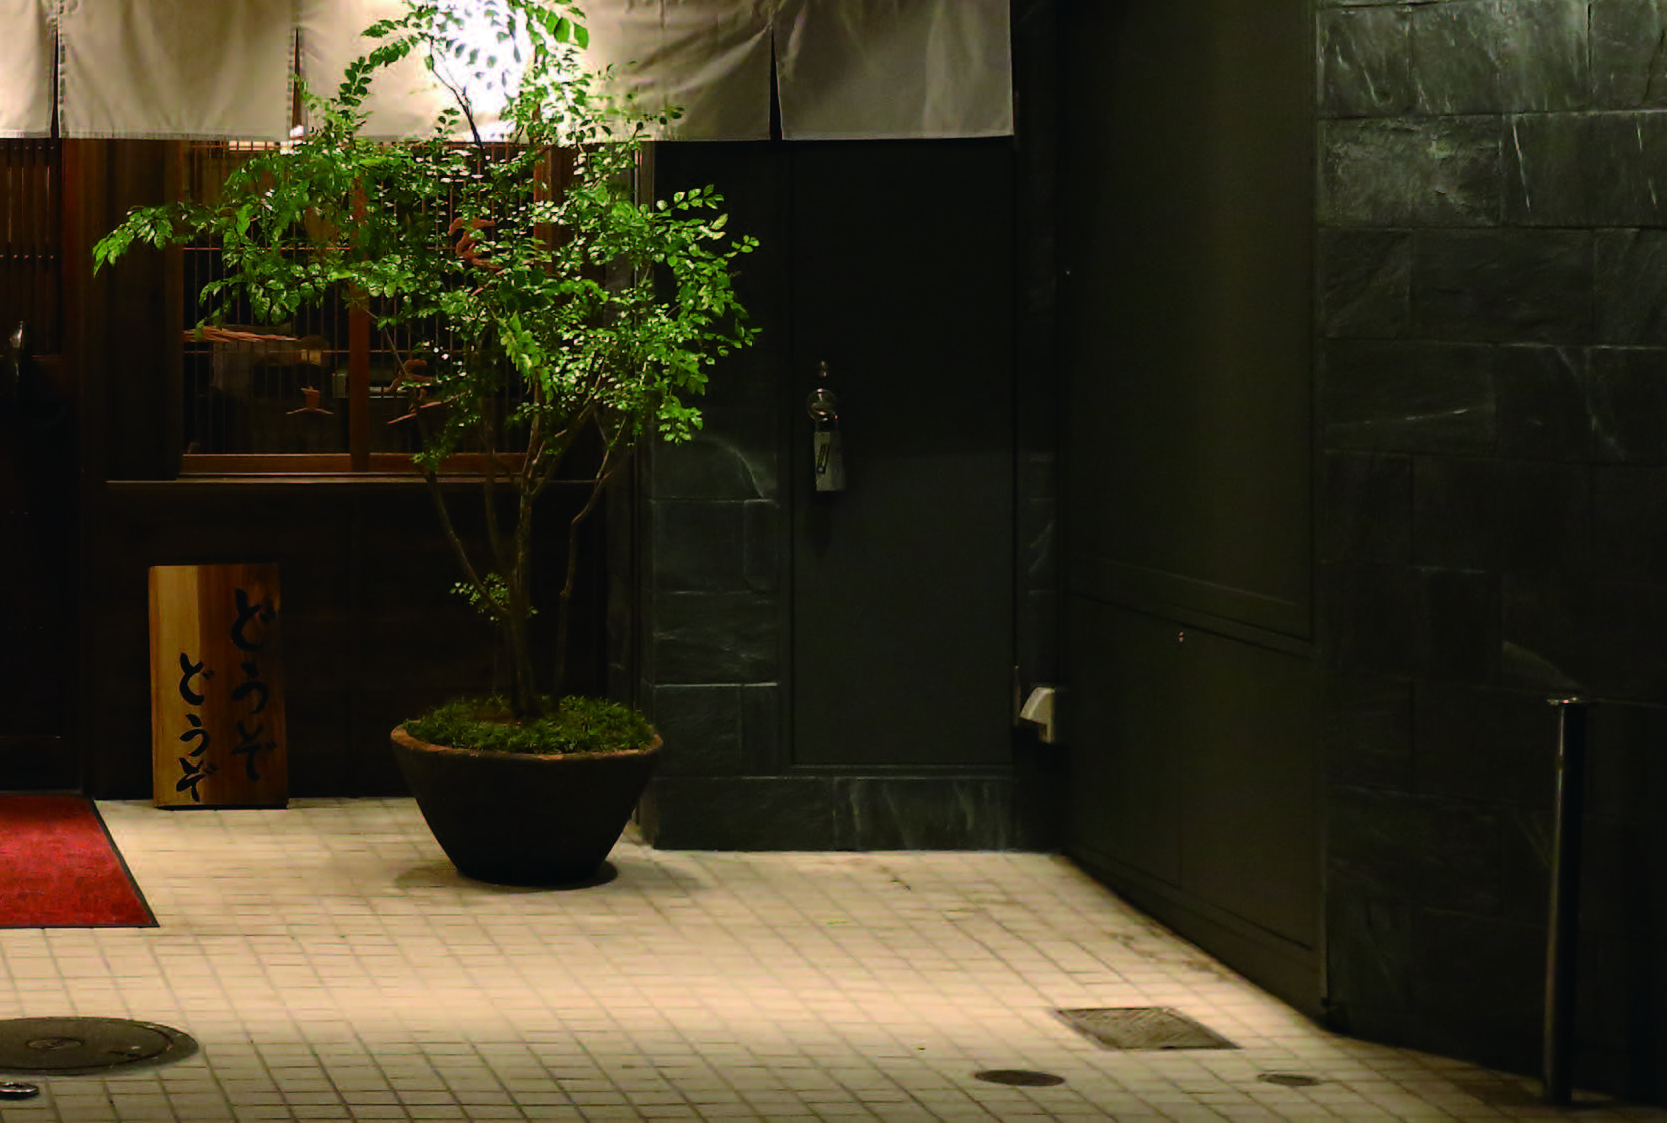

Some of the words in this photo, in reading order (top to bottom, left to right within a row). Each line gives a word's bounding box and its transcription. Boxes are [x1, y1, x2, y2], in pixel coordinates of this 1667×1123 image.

[176, 652, 216, 802] どうぞ
[230, 588, 278, 782] どうぞ
